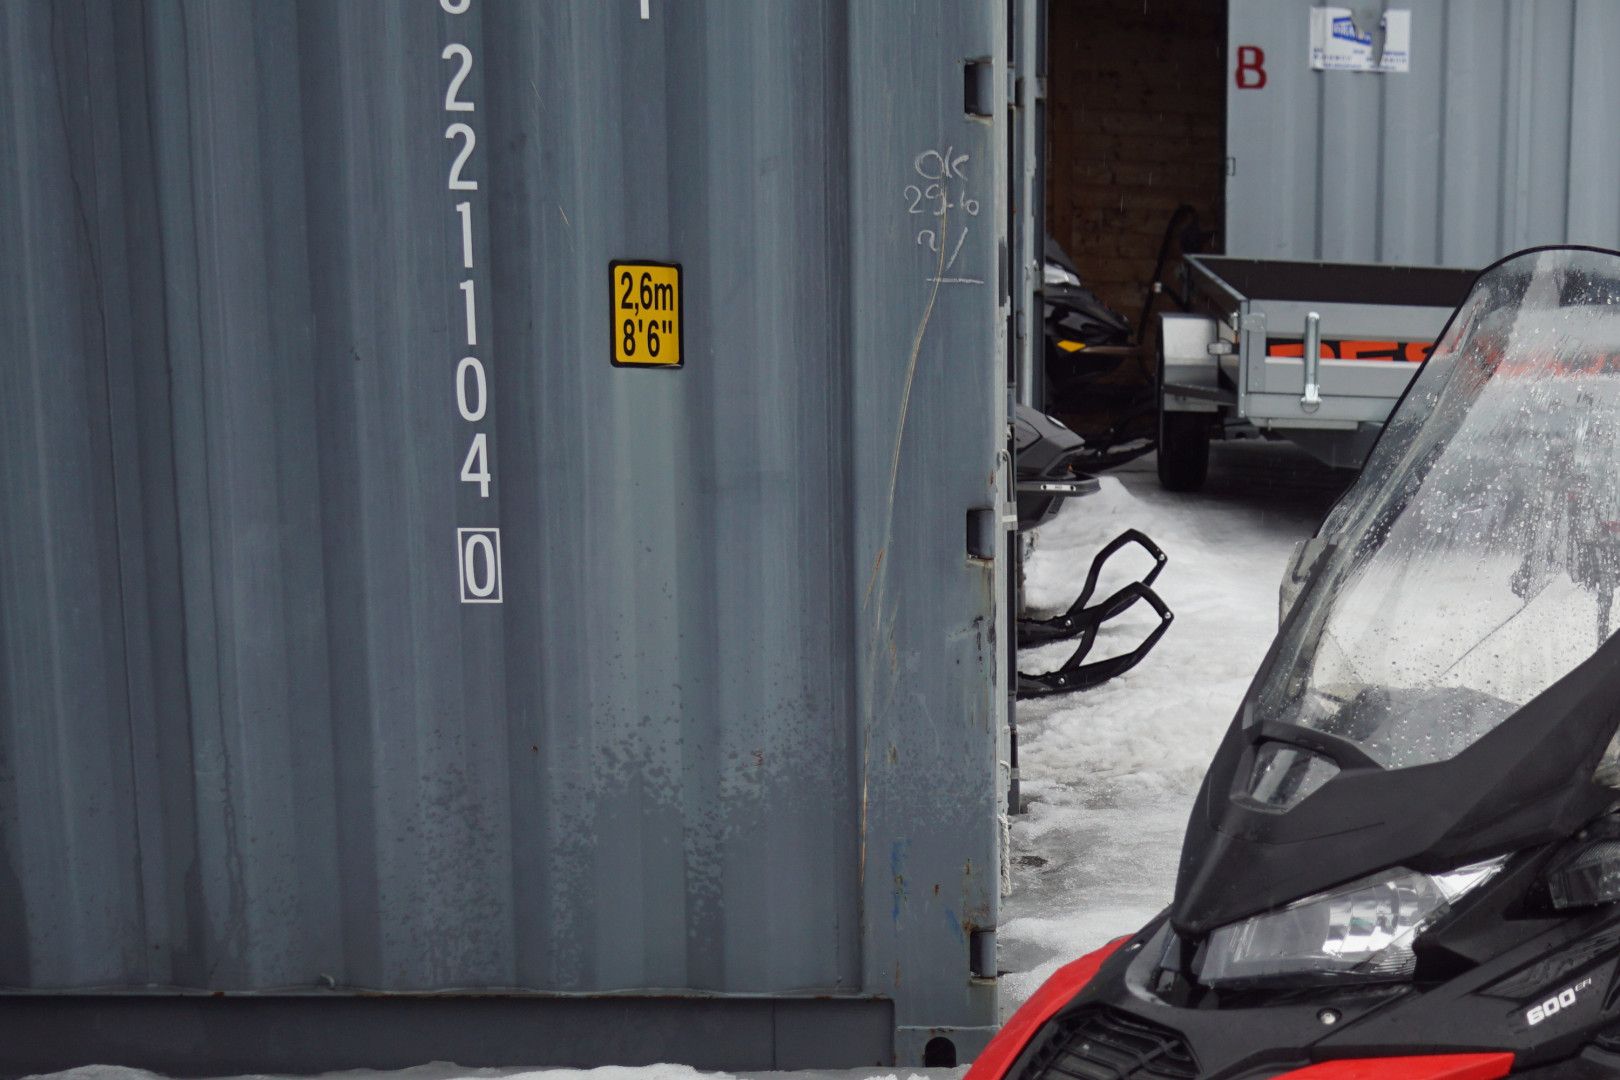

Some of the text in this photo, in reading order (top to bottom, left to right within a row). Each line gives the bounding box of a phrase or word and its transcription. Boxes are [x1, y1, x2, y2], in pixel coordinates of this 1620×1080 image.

[1235, 45, 1267, 89] B
[914, 146, 969, 181] OK
[621, 271, 674, 317] 2,6m
[1526, 977, 1592, 1026] 600 EFI
